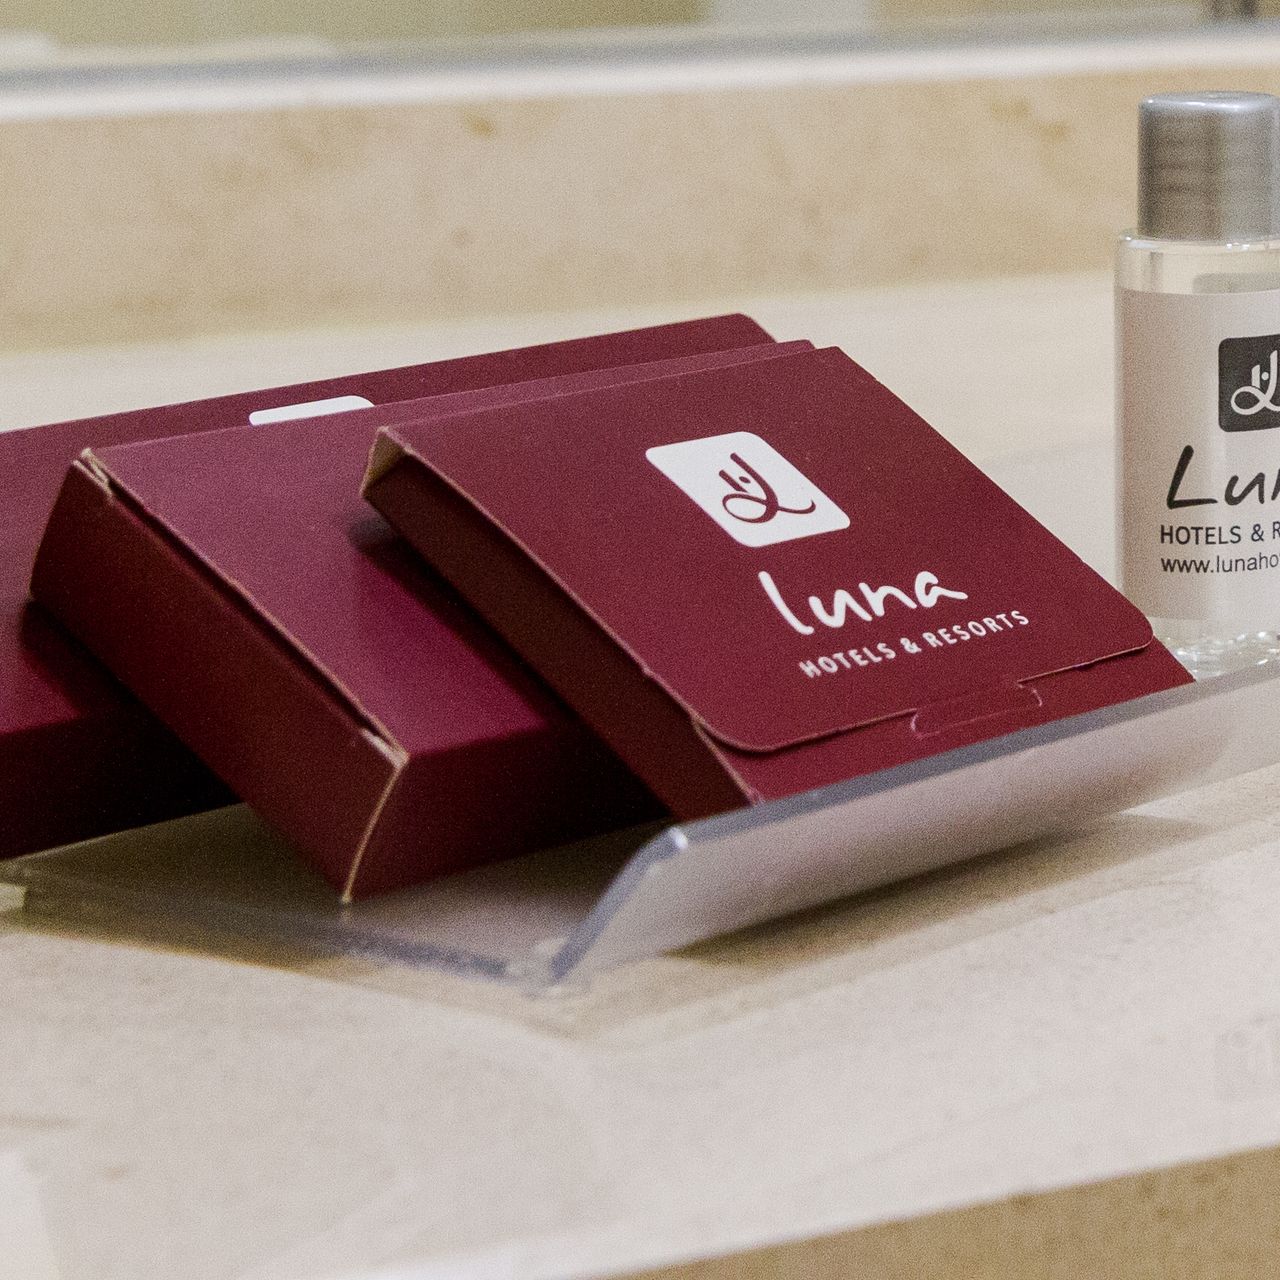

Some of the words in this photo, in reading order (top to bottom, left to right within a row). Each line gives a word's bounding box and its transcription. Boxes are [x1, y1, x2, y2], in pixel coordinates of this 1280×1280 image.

[1160, 524, 1242, 545] HOTELS
[1251, 523, 1265, 542] &
[758, 571, 969, 635] luna
[799, 642, 896, 678] HOTELS
[900, 637, 922, 654] &
[922, 610, 1029, 648] RESORTS
